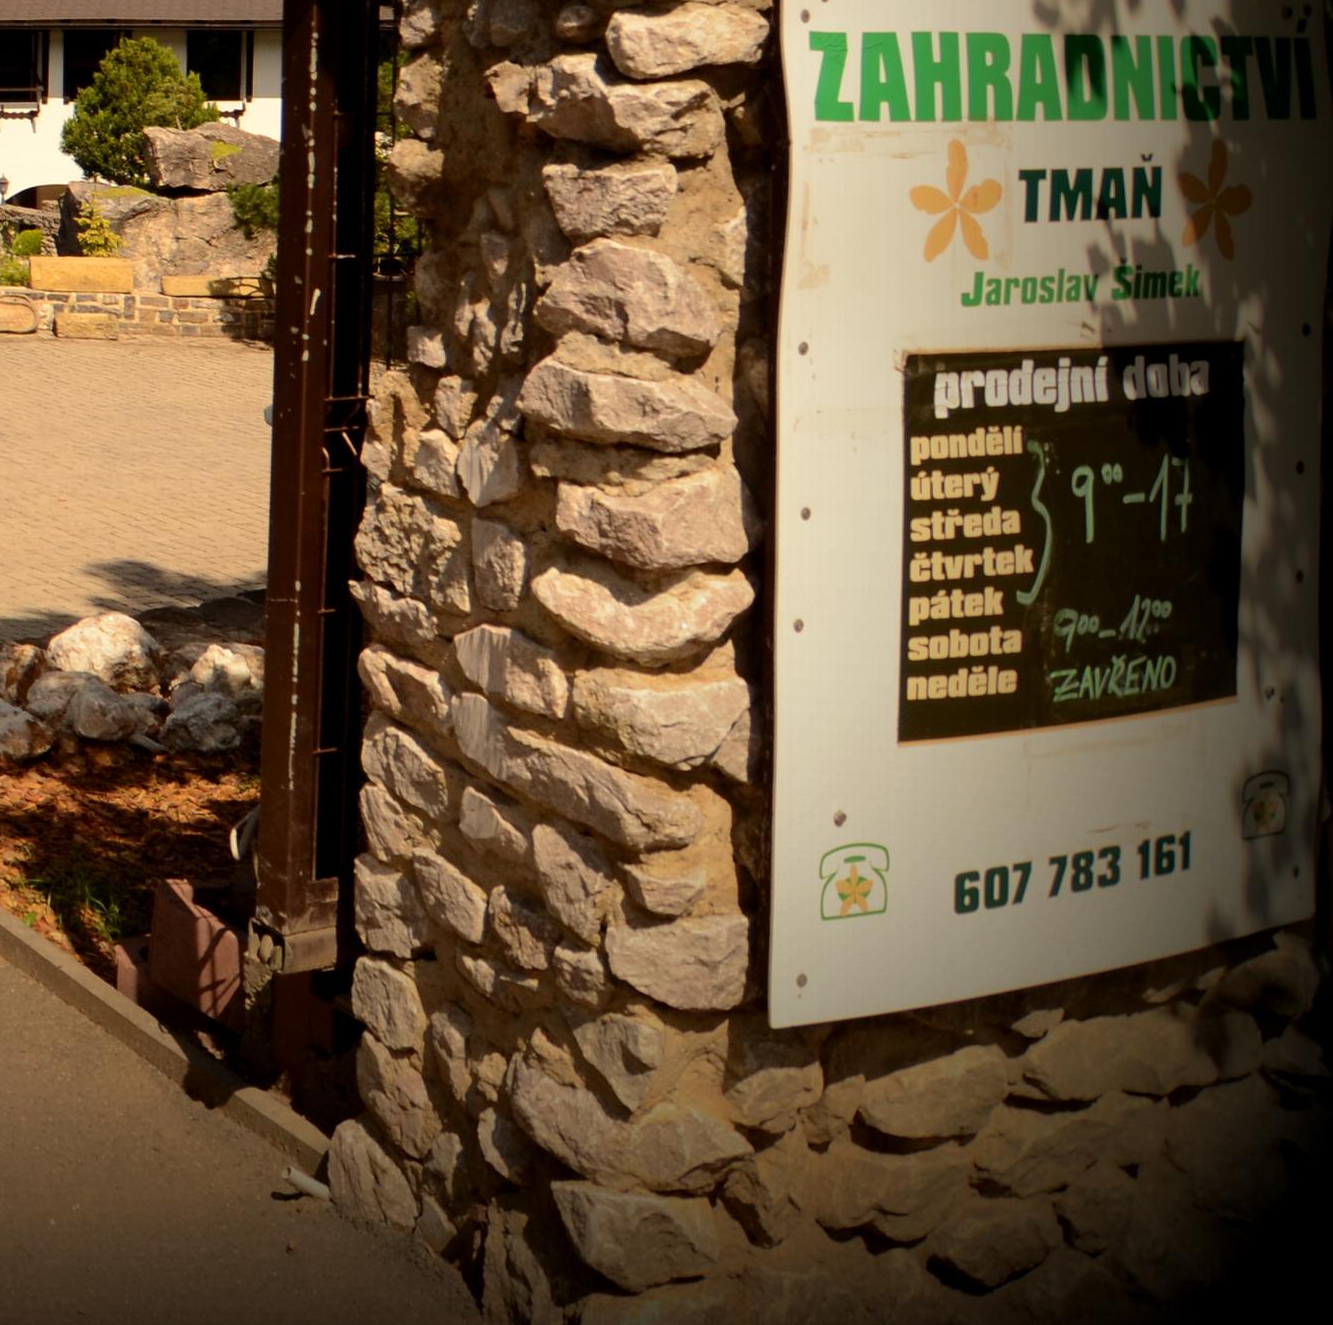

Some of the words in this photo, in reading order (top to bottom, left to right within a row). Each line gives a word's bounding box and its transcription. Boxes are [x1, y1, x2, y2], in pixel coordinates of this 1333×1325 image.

[808, 18, 1318, 123] ZAHRADNICTVÍ
[1018, 154, 1163, 224] TMAŇ
[960, 268, 1099, 308] Jaroslav
[1111, 258, 1202, 302] Šimek
[934, 356, 1110, 419] prodejní
[1122, 353, 1211, 402] doba
[909, 425, 1024, 466] pondělí
[909, 466, 1000, 502] úterý
[909, 507, 1021, 543] středa
[908, 544, 1034, 584] čtvrtek
[908, 586, 1004, 627] pátek
[906, 627, 1022, 662] sobota
[906, 666, 1018, 702] neděle
[953, 861, 1033, 915] 607
[1047, 845, 1123, 898] 783
[1137, 831, 1192, 880] 161
